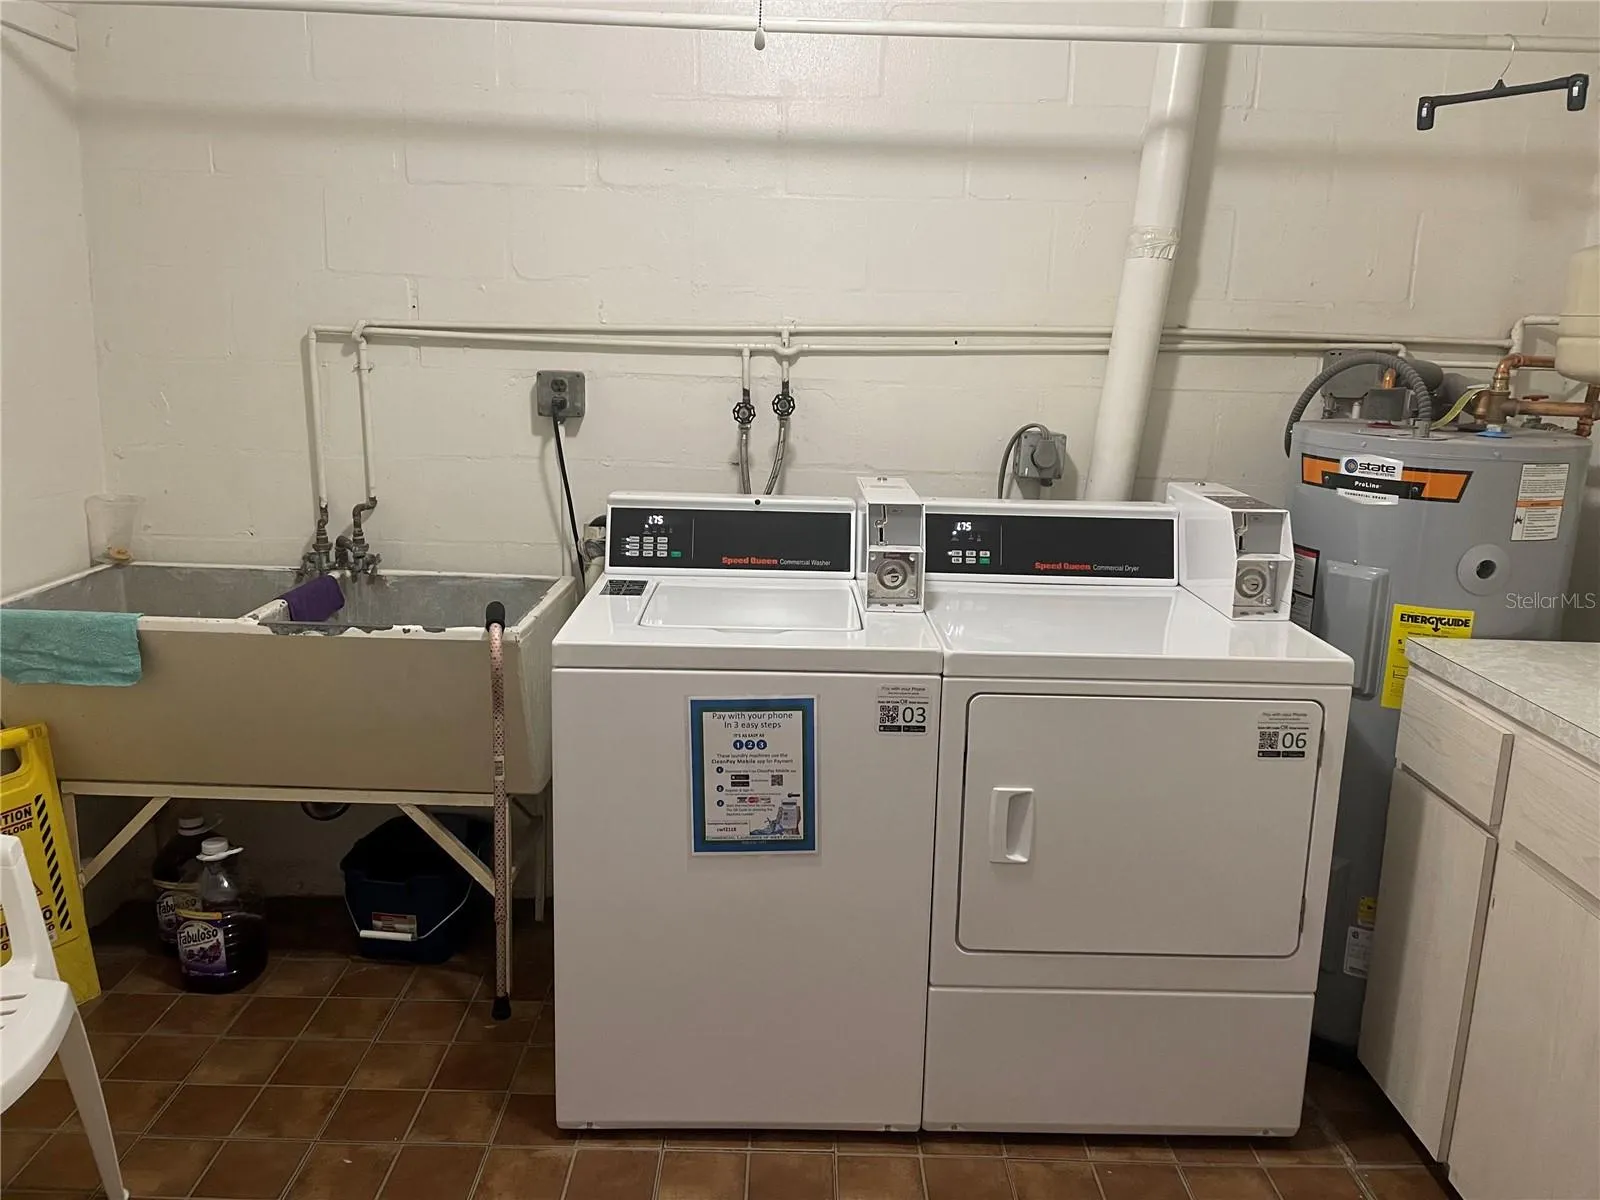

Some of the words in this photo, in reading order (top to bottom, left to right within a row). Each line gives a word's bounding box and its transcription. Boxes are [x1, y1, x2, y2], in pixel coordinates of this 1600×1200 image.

[1359, 462, 1396, 474] state
[1354, 481, 1380, 489] ProLine
[722, 557, 749, 565] Speed
[750, 557, 778, 565] Queen
[779, 558, 810, 566] Commercial
[1034, 562, 1062, 570] Speed
[1063, 562, 1091, 570] Queen
[1092, 564, 1123, 572] Commercial
[1124, 565, 1140, 573] Dryer
[712, 712, 726, 721] Pay
[728, 712, 747, 720] with
[748, 713, 765, 721] your
[767, 711, 793, 720] phone
[902, 706, 926, 724] 03
[741, 722, 759, 730] easy
[760, 722, 782, 730] steps
[1282, 732, 1307, 749] 06
[178, 928, 219, 946] Fabuloso
